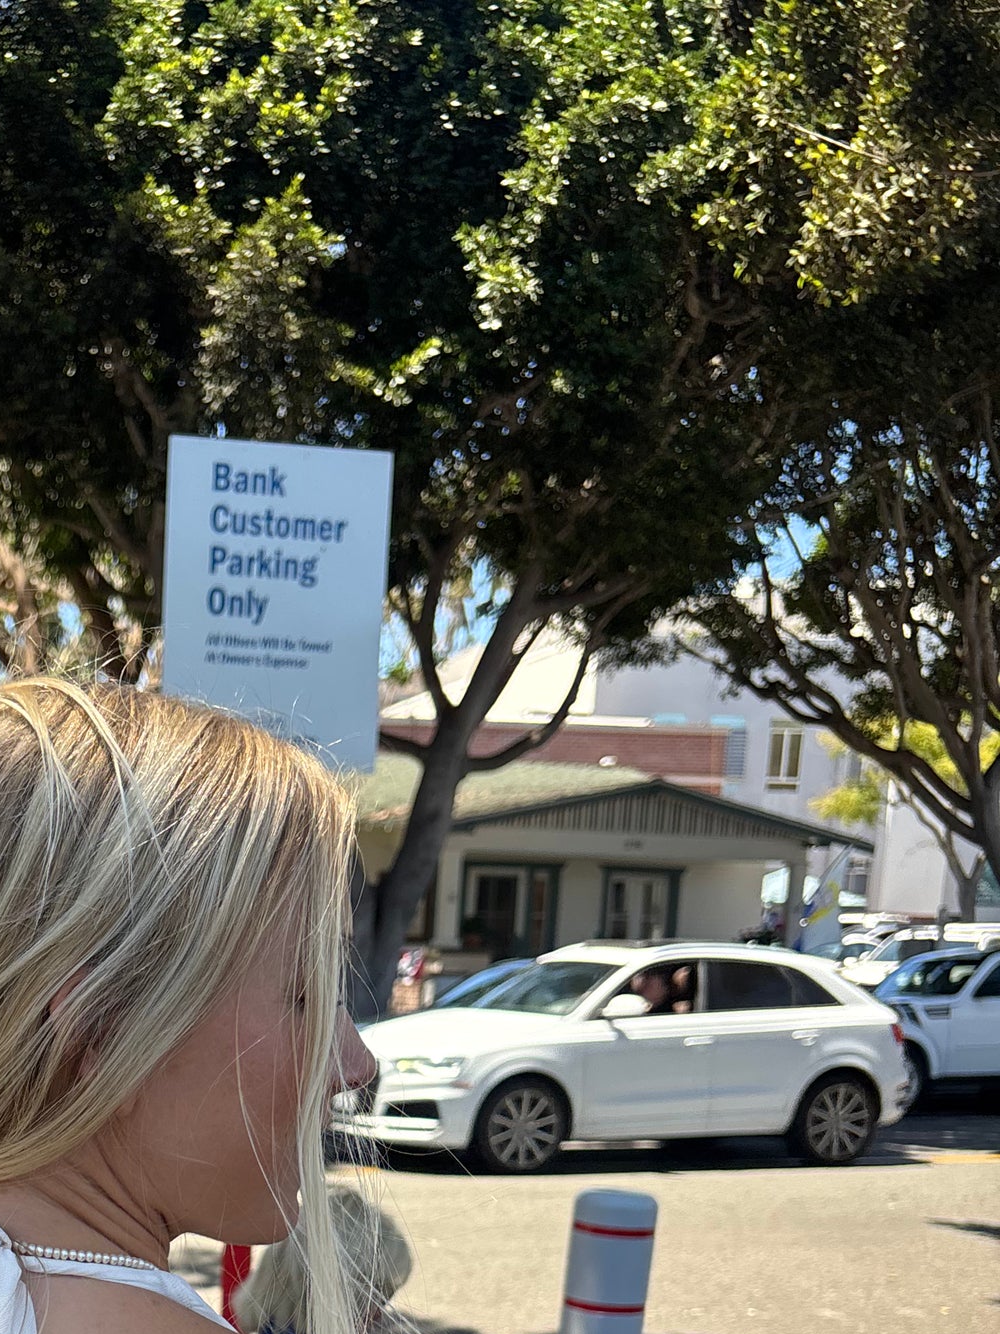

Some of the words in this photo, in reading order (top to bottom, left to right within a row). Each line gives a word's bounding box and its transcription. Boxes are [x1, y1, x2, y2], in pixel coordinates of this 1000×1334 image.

[213, 462, 287, 497] Bank
[210, 504, 347, 542] Customer
[208, 545, 319, 588] Parking
[207, 586, 269, 625] Only
